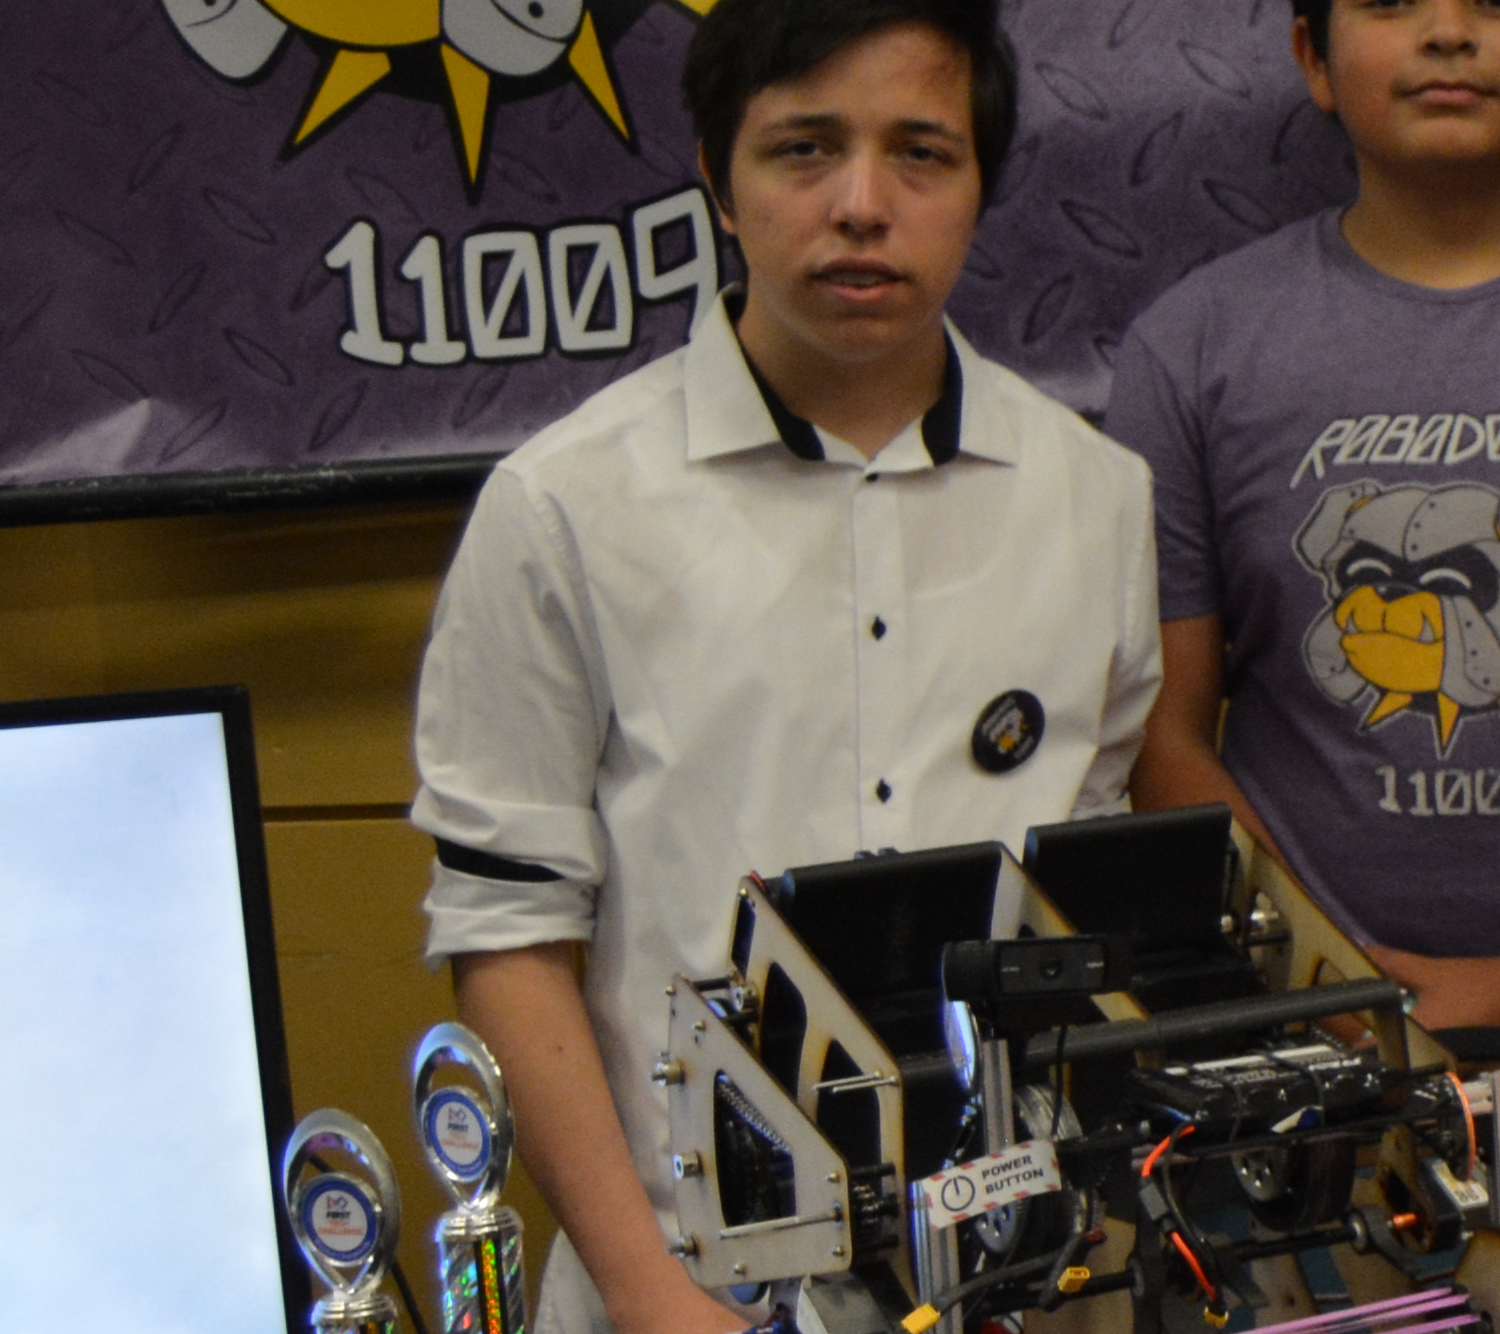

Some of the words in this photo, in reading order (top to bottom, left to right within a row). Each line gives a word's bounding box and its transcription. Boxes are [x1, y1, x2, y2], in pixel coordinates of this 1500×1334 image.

[324, 186, 724, 367] 11009
[981, 1154, 1033, 1180] POWER
[985, 1168, 1045, 1194] BUTTON
